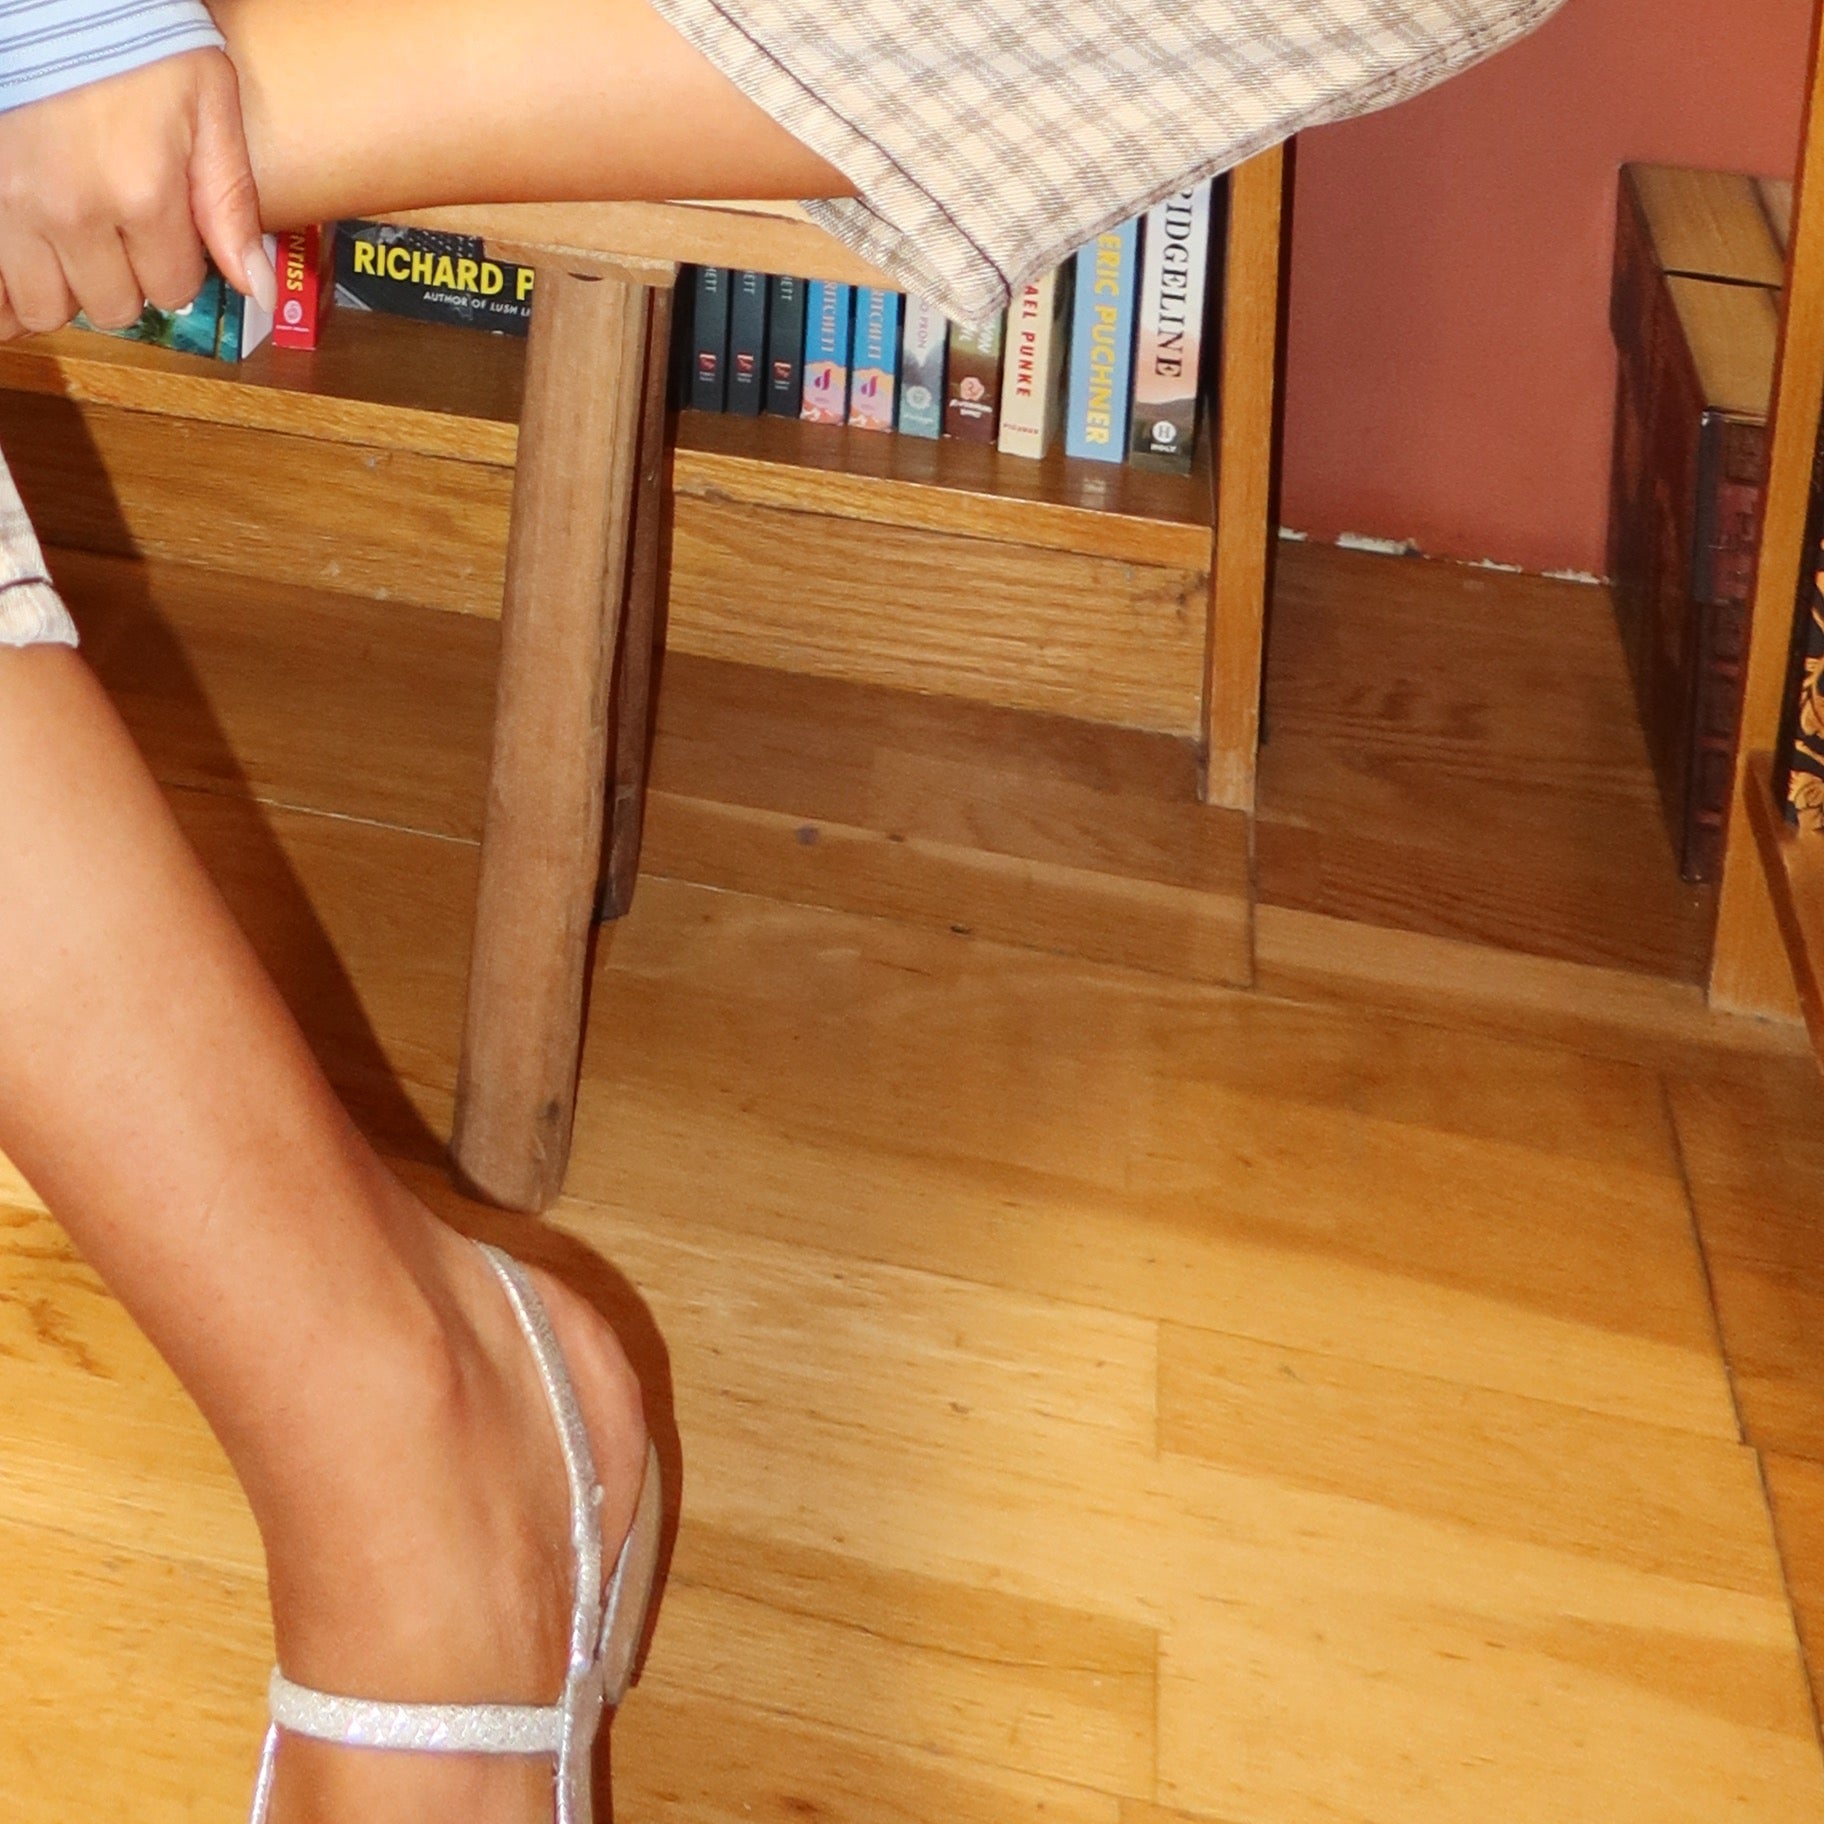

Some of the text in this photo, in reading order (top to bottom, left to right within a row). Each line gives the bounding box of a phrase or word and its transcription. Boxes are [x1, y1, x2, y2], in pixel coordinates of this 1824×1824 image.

[352, 242, 505, 294] RICHARD
[1085, 234, 1122, 445] ERIC PUCHNER
